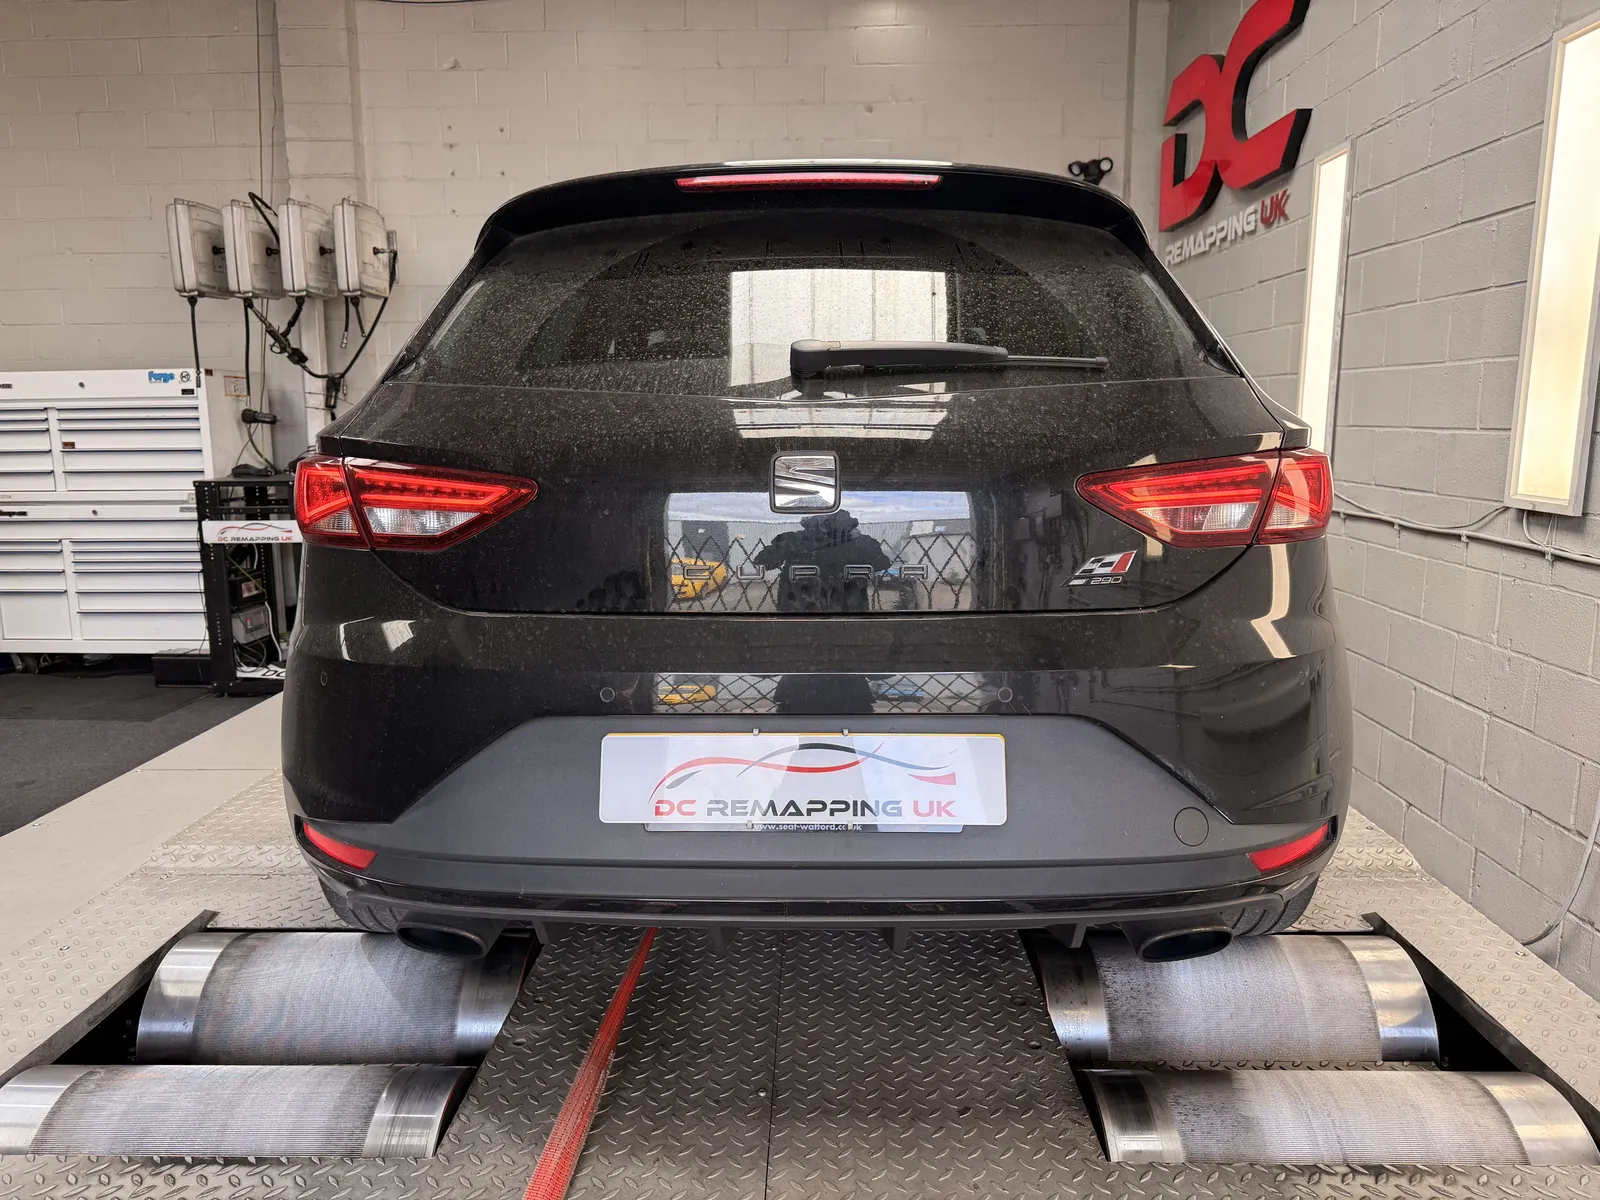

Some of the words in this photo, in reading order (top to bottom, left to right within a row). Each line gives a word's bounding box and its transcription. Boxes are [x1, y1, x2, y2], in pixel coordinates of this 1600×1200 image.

[1159, 0, 1310, 233] DC
[1165, 204, 1257, 268] REMAPPING
[1260, 188, 1290, 226] UK
[683, 564, 928, 580] CUPRA
[1090, 576, 1122, 585] 290
[655, 800, 696, 816] DC
[707, 799, 902, 817] REMAPPING
[913, 800, 956, 817] UK
[753, 823, 862, 831] www.seat-watford.couk
